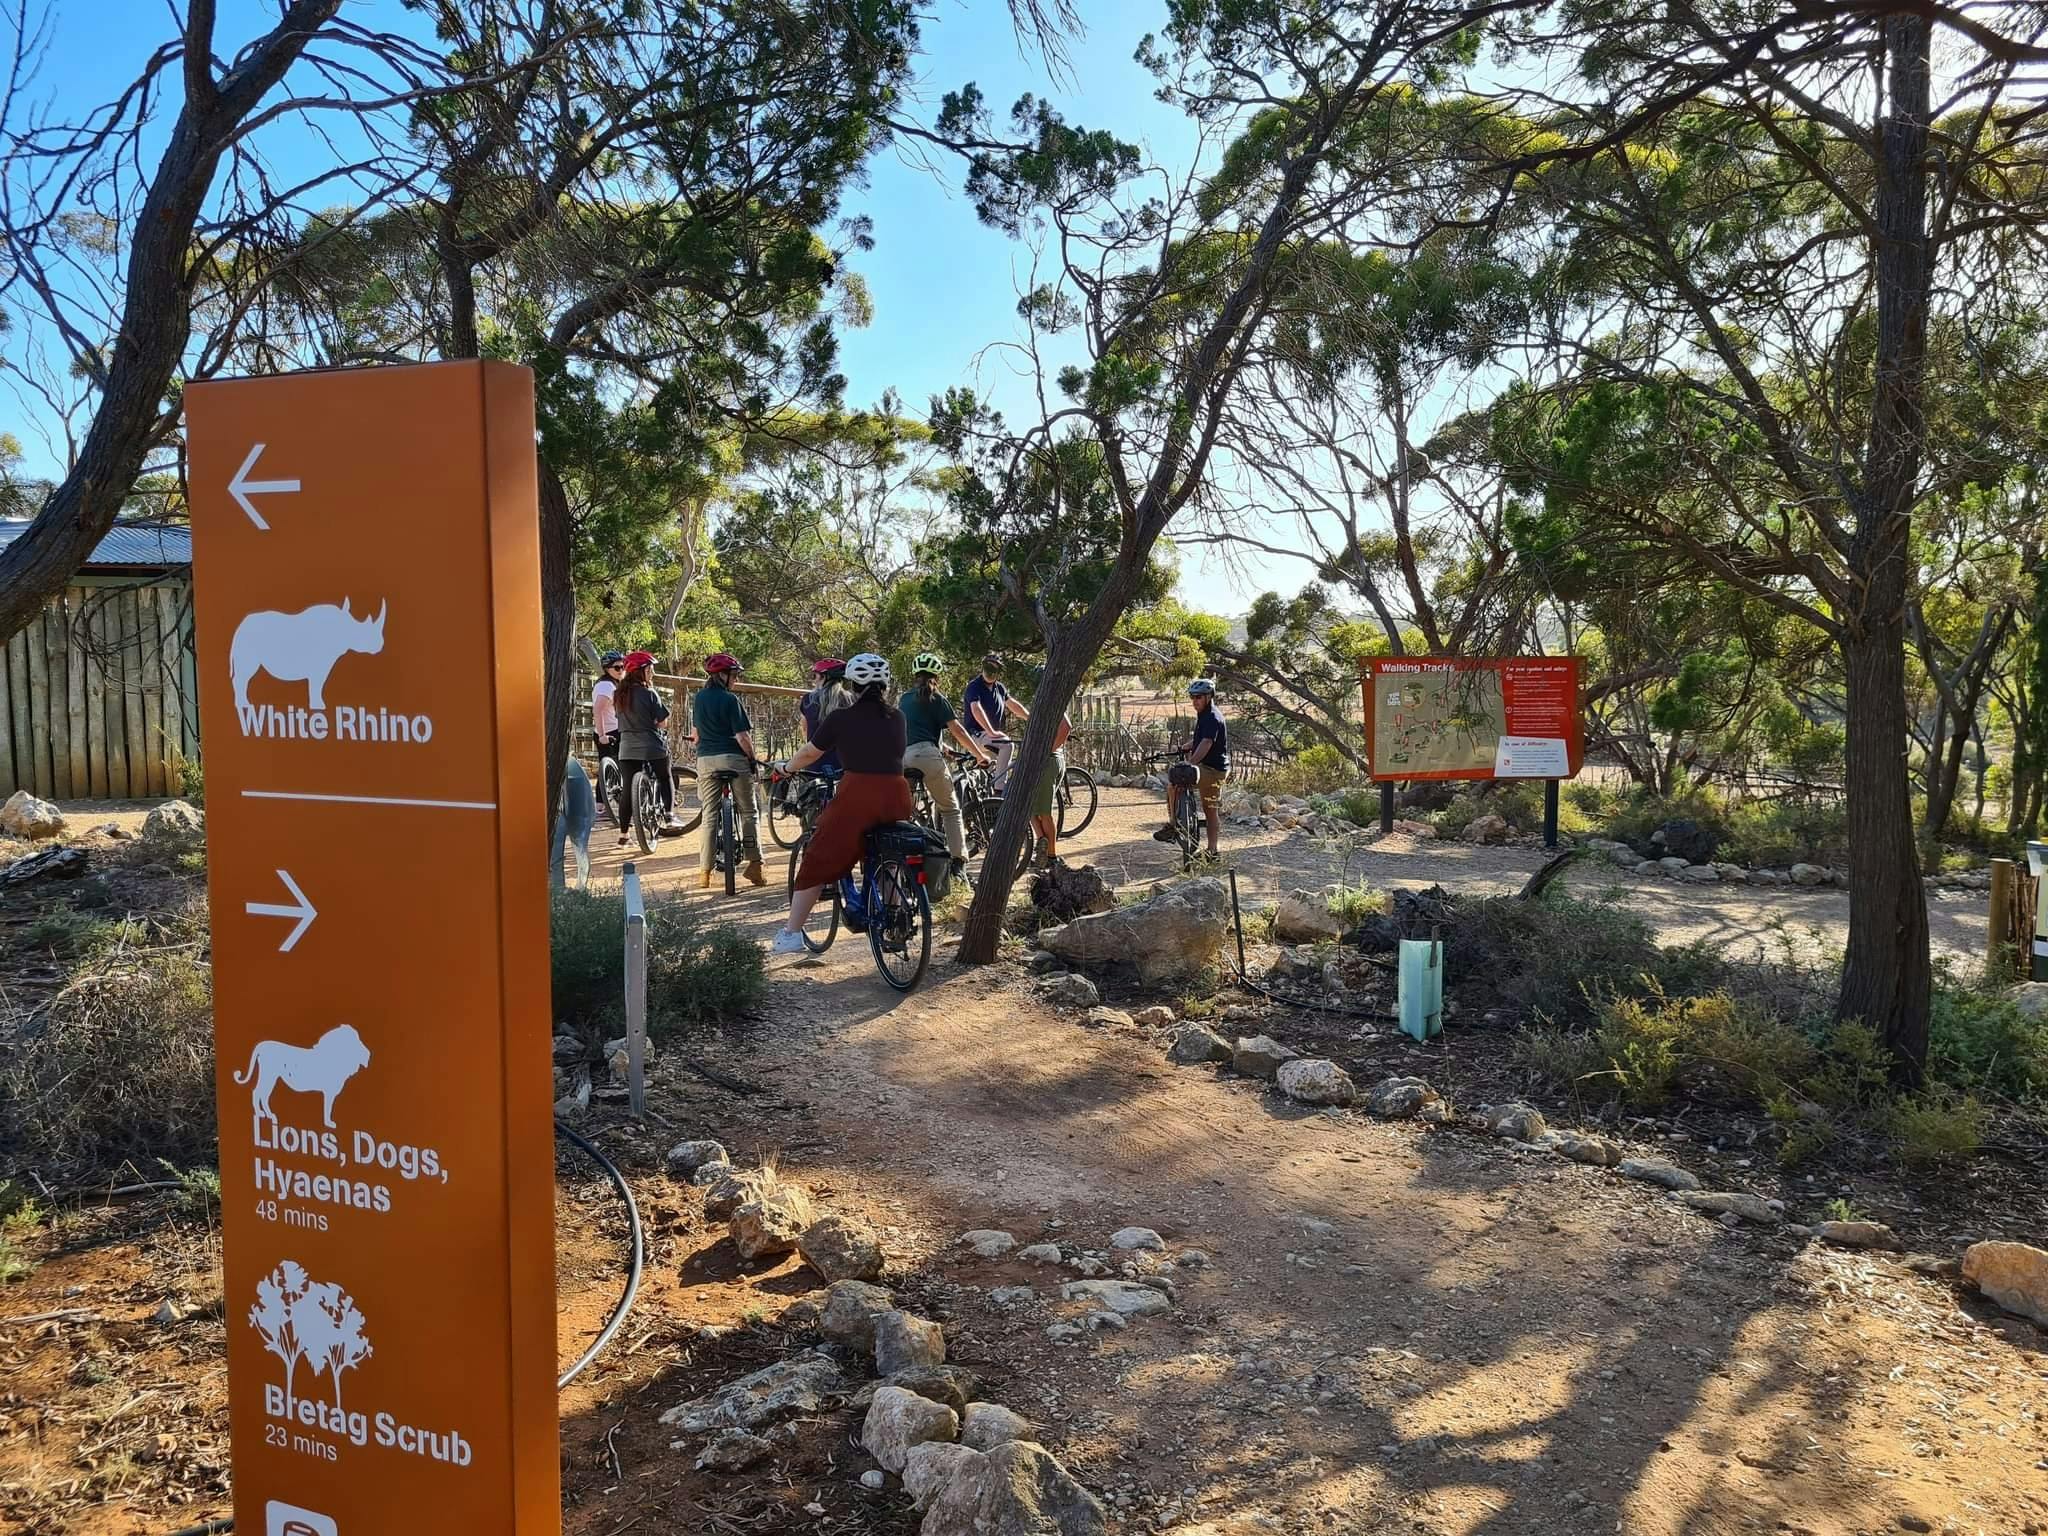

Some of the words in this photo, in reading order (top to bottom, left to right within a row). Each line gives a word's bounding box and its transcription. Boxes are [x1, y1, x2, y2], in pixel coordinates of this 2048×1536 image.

[1381, 663, 1421, 674] Walking
[1422, 663, 1456, 673] Tracks
[236, 704, 329, 740] White
[335, 705, 433, 744] Rhino
[252, 1113, 346, 1167] Lions,
[353, 1130, 449, 1185] Dogs,
[254, 1157, 392, 1213] Hyaenas
[255, 1199, 278, 1222] 48
[284, 1206, 329, 1232] mins
[264, 1383, 368, 1447] Bretag
[374, 1412, 472, 1467] Scrub
[264, 1423, 288, 1447] 23
[293, 1435, 338, 1462] mins
